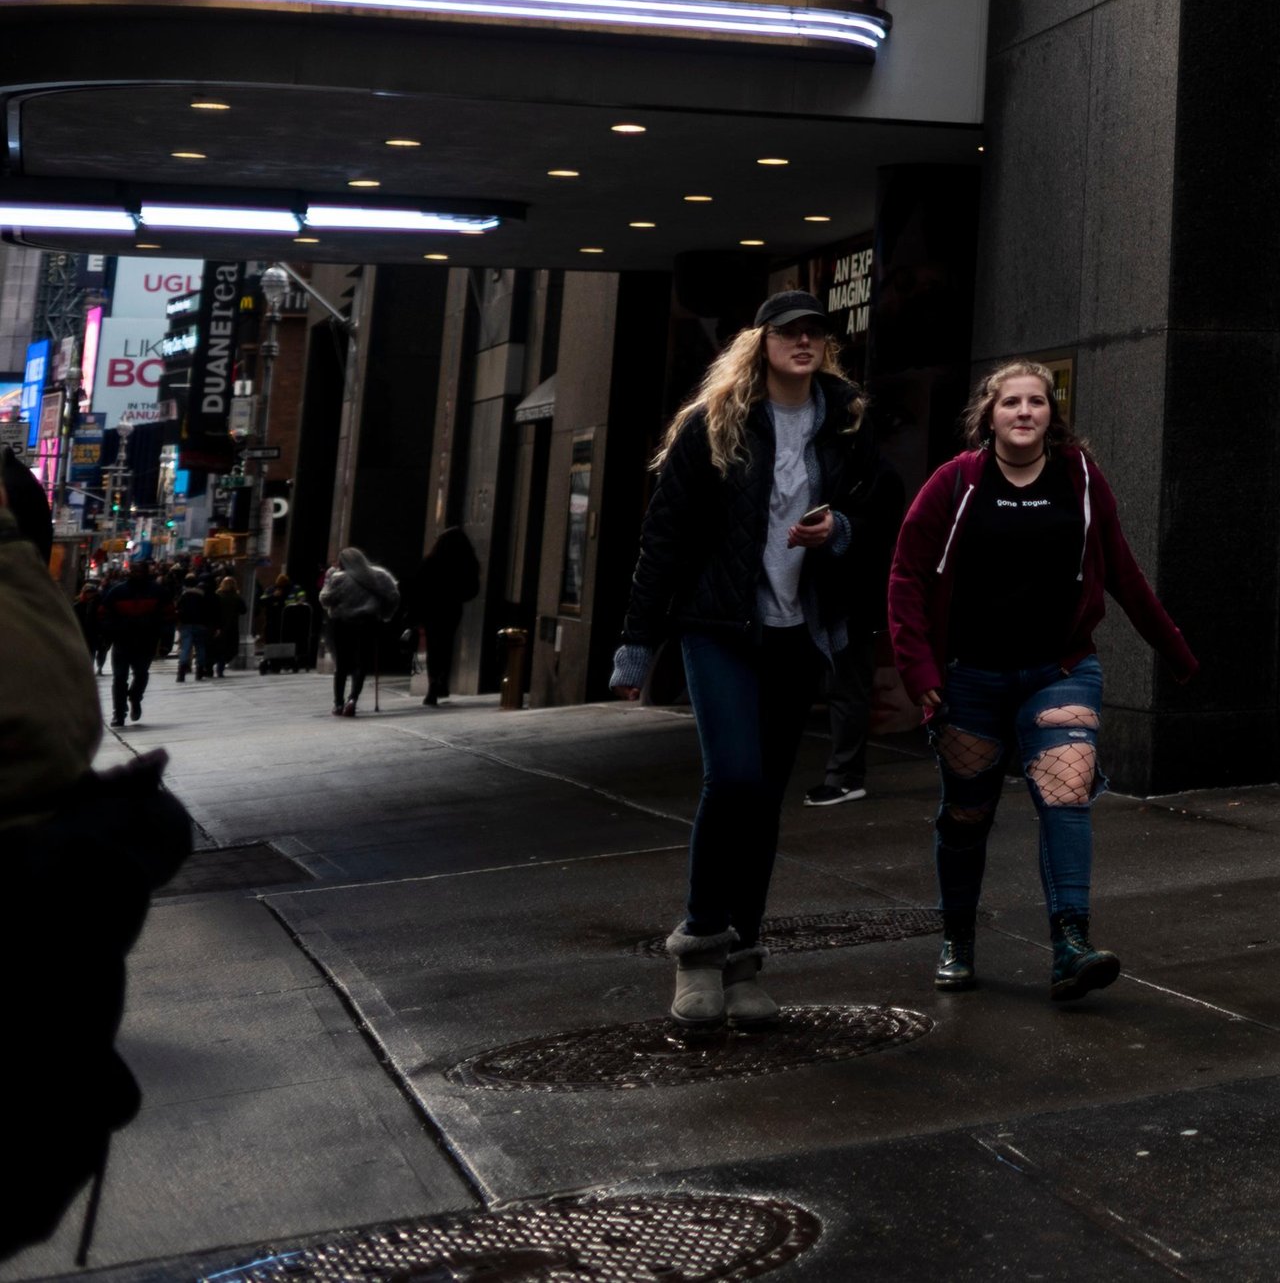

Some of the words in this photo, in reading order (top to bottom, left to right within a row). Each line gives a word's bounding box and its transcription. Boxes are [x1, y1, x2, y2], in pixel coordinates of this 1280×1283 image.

[834, 255, 850, 284] AN
[846, 309, 855, 335] A
[997, 498, 1017, 507] gone
[1022, 498, 1051, 508] rogue.
